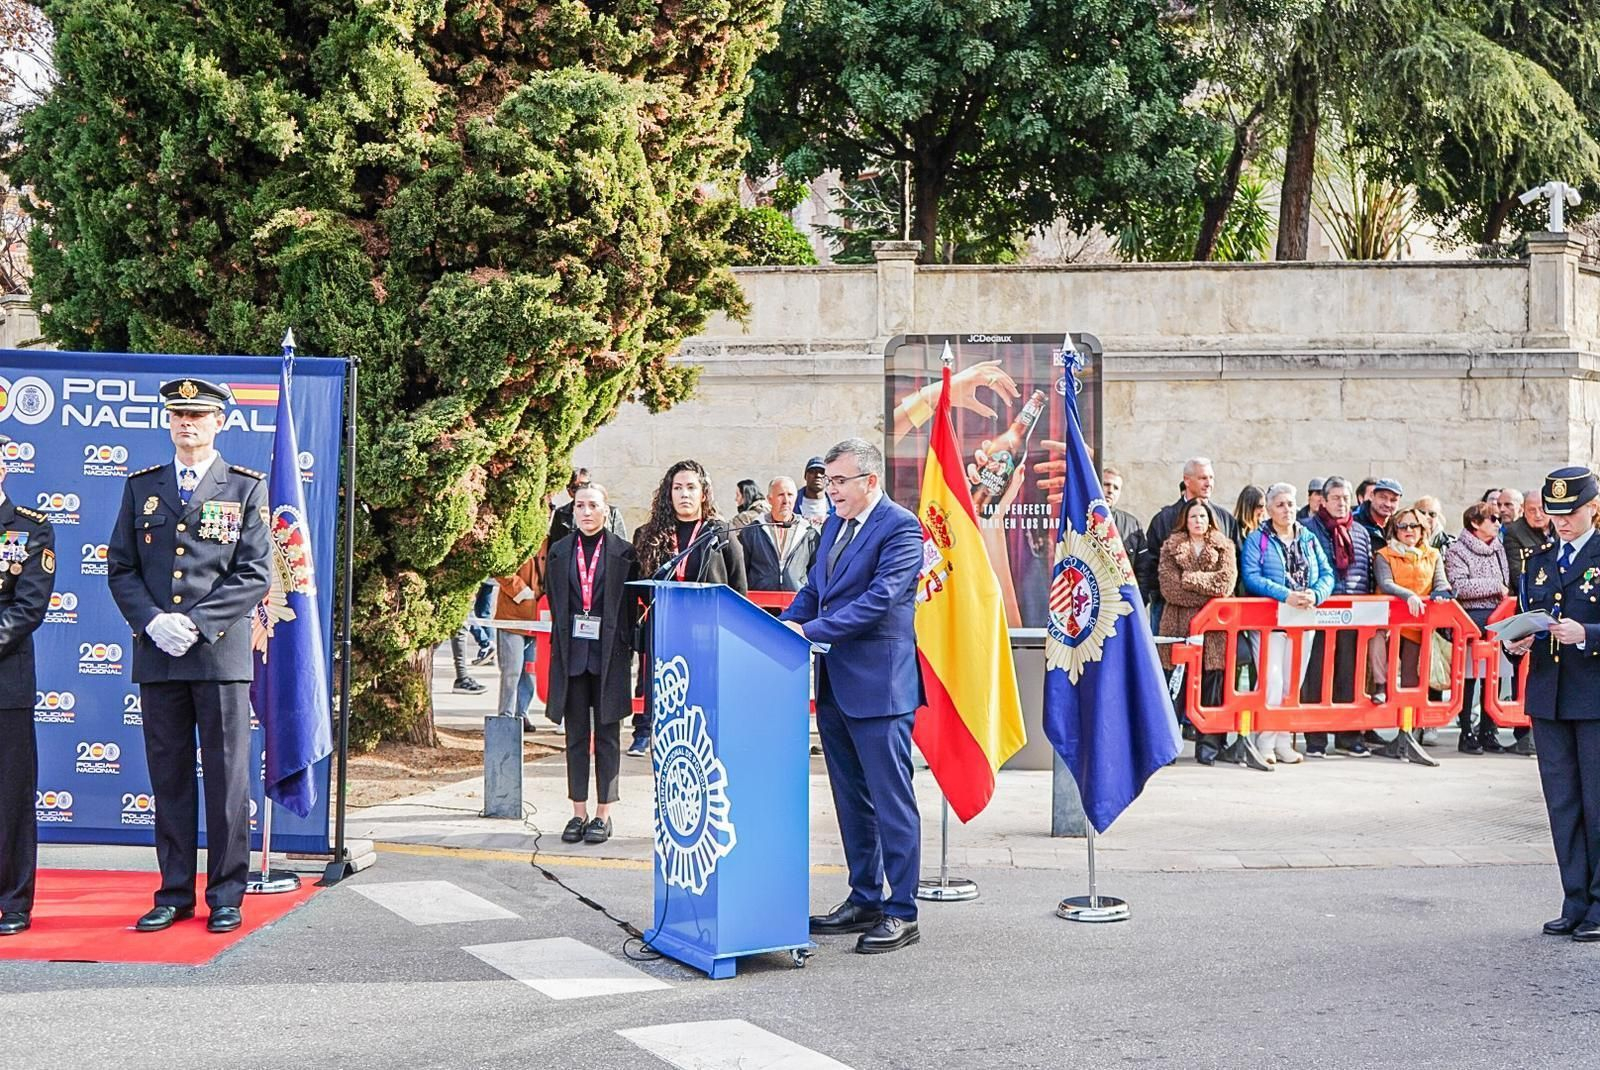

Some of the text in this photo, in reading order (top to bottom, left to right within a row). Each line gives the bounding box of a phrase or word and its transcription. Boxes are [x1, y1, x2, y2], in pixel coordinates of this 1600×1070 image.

[967, 334, 1012, 343] JCDecaux
[62, 403, 277, 433] NACIAL
[84, 444, 129, 464] 200
[37, 492, 80, 512] 200
[1005, 503, 1052, 515] PERFECTO
[1004, 518, 1016, 530] EN
[1021, 518, 1038, 530] LOS
[81, 543, 109, 562] 20
[1080, 565, 1099, 610] NACIONAL
[1088, 616, 1097, 630] DE
[79, 642, 123, 662] 200
[76, 741, 120, 761] 200
[685, 748, 693, 760] DE
